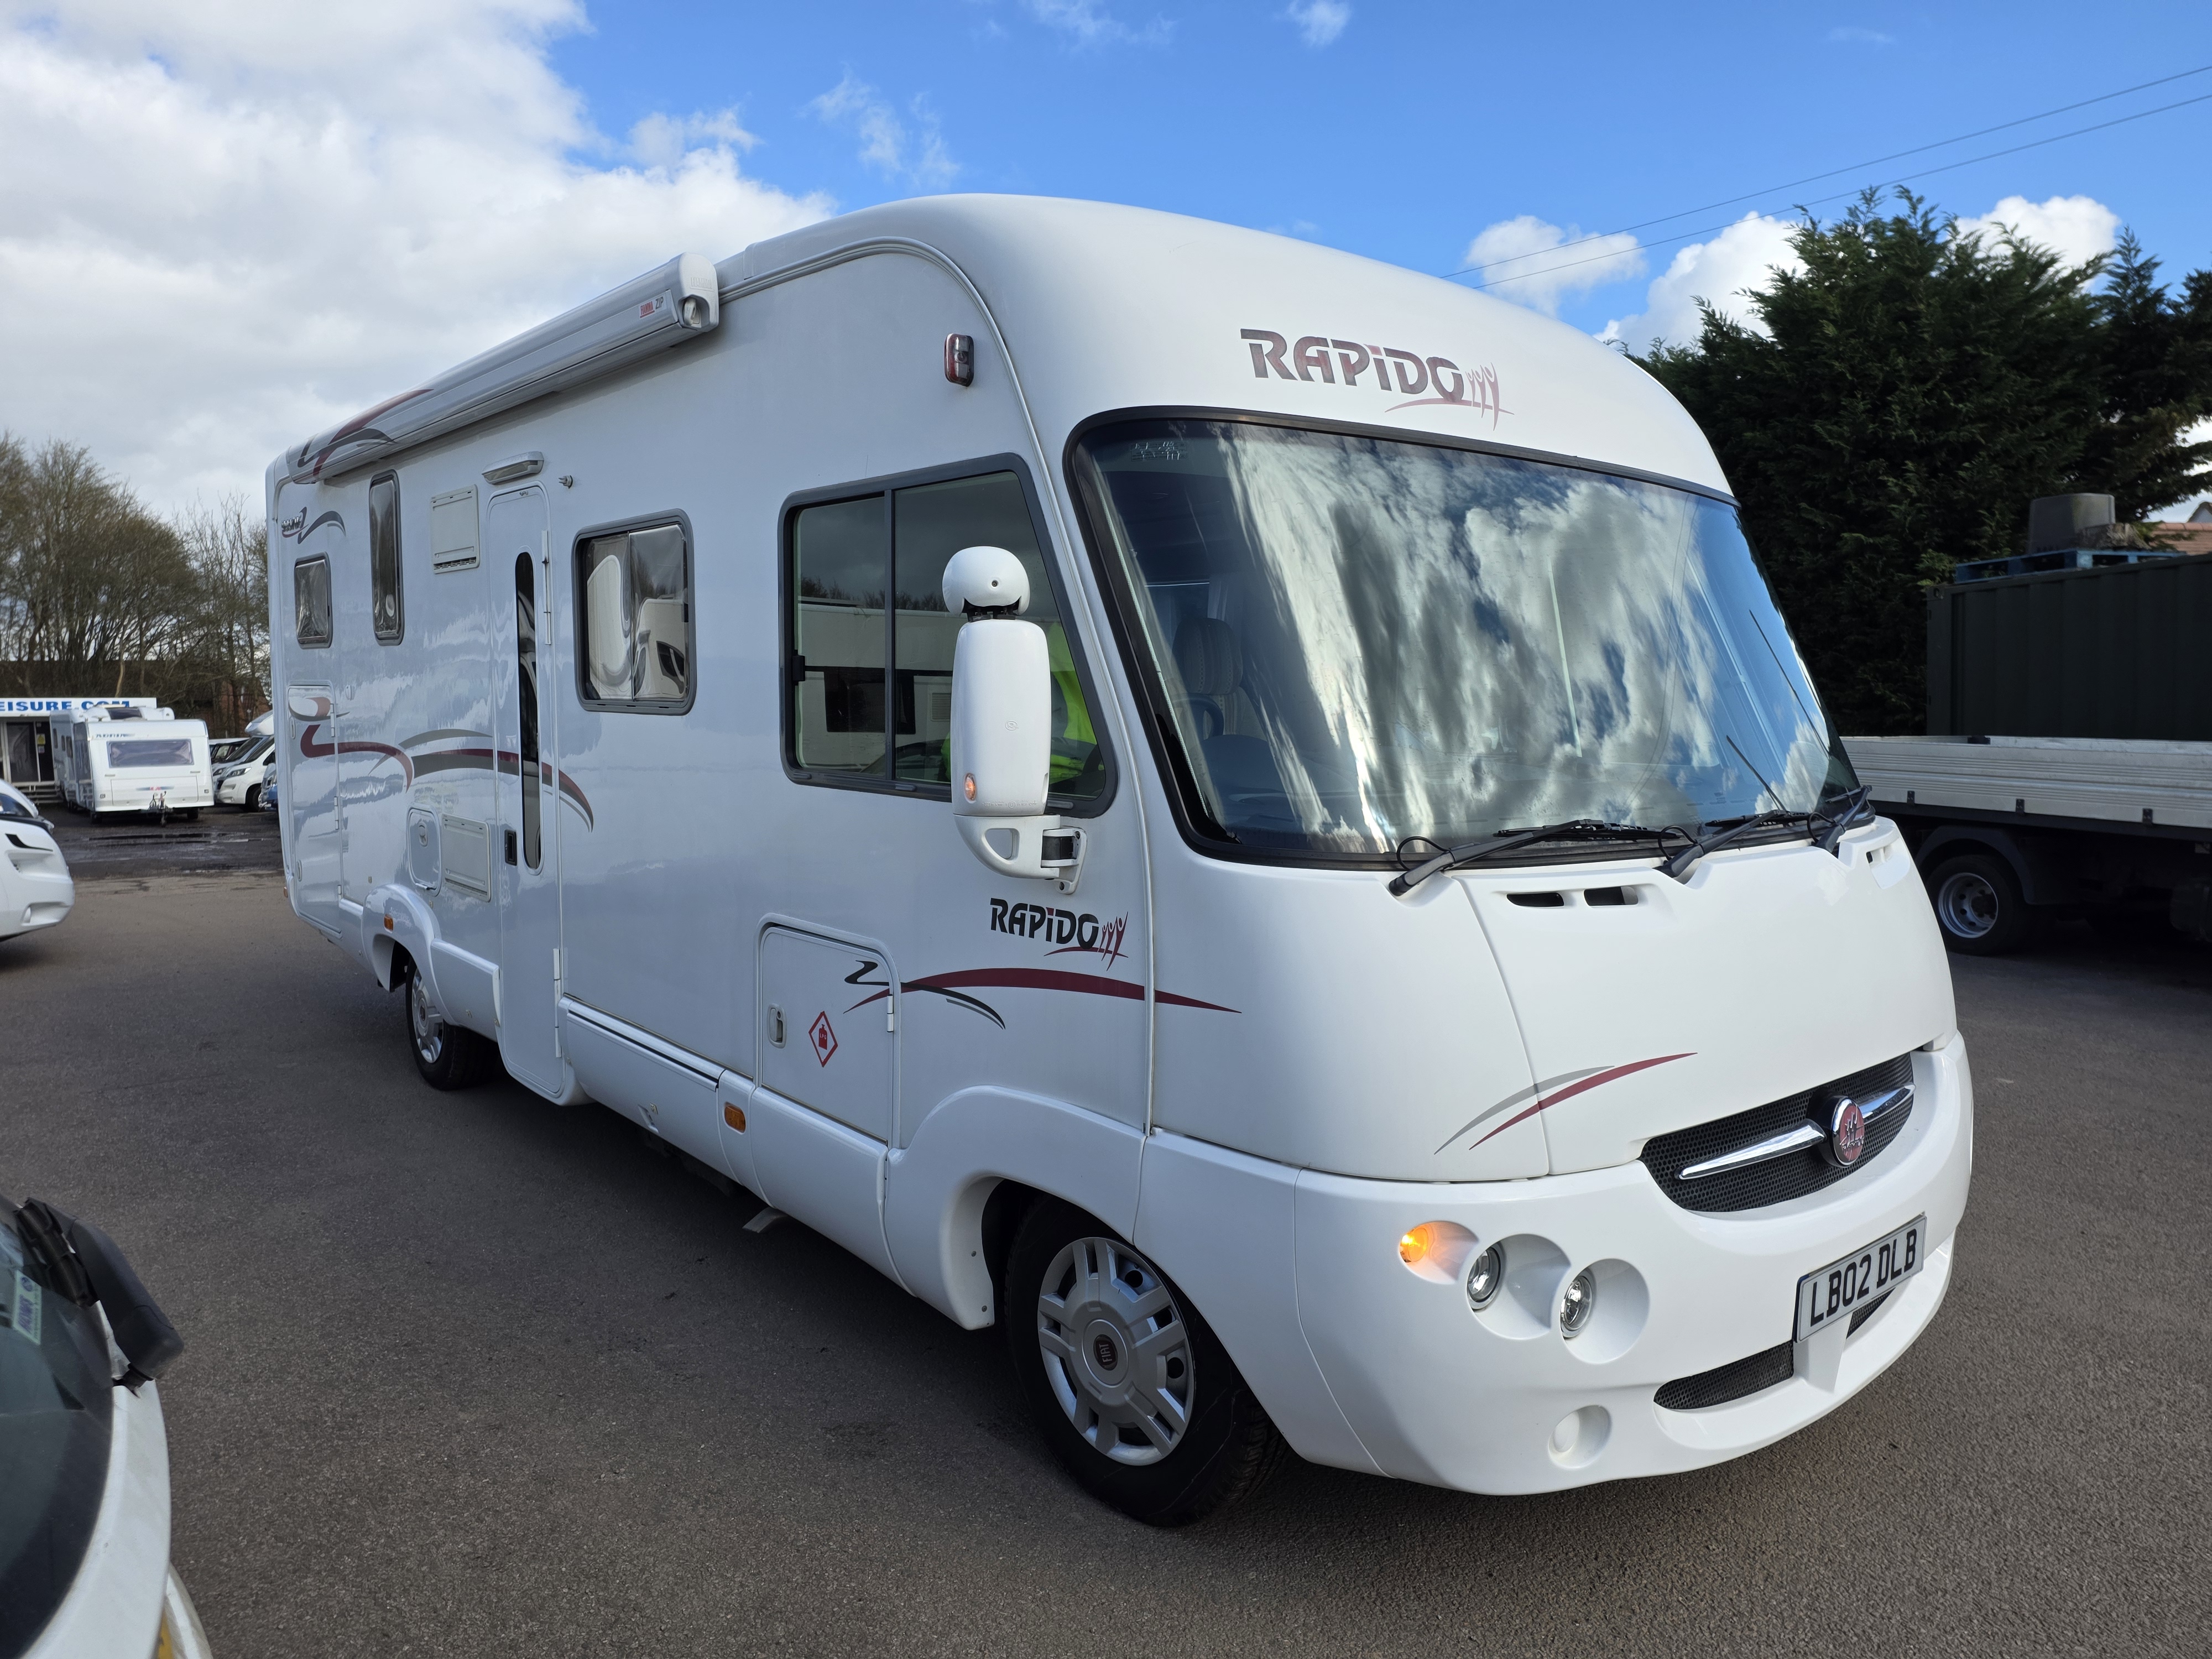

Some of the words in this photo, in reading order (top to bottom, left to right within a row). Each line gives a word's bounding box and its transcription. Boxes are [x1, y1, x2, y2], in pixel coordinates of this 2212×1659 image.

[655, 296, 664, 309] ZIP
[1810, 1254, 1871, 1327] LB02
[1876, 1228, 1917, 1289] DLB
[1099, 1344, 1113, 1362] FIAT
